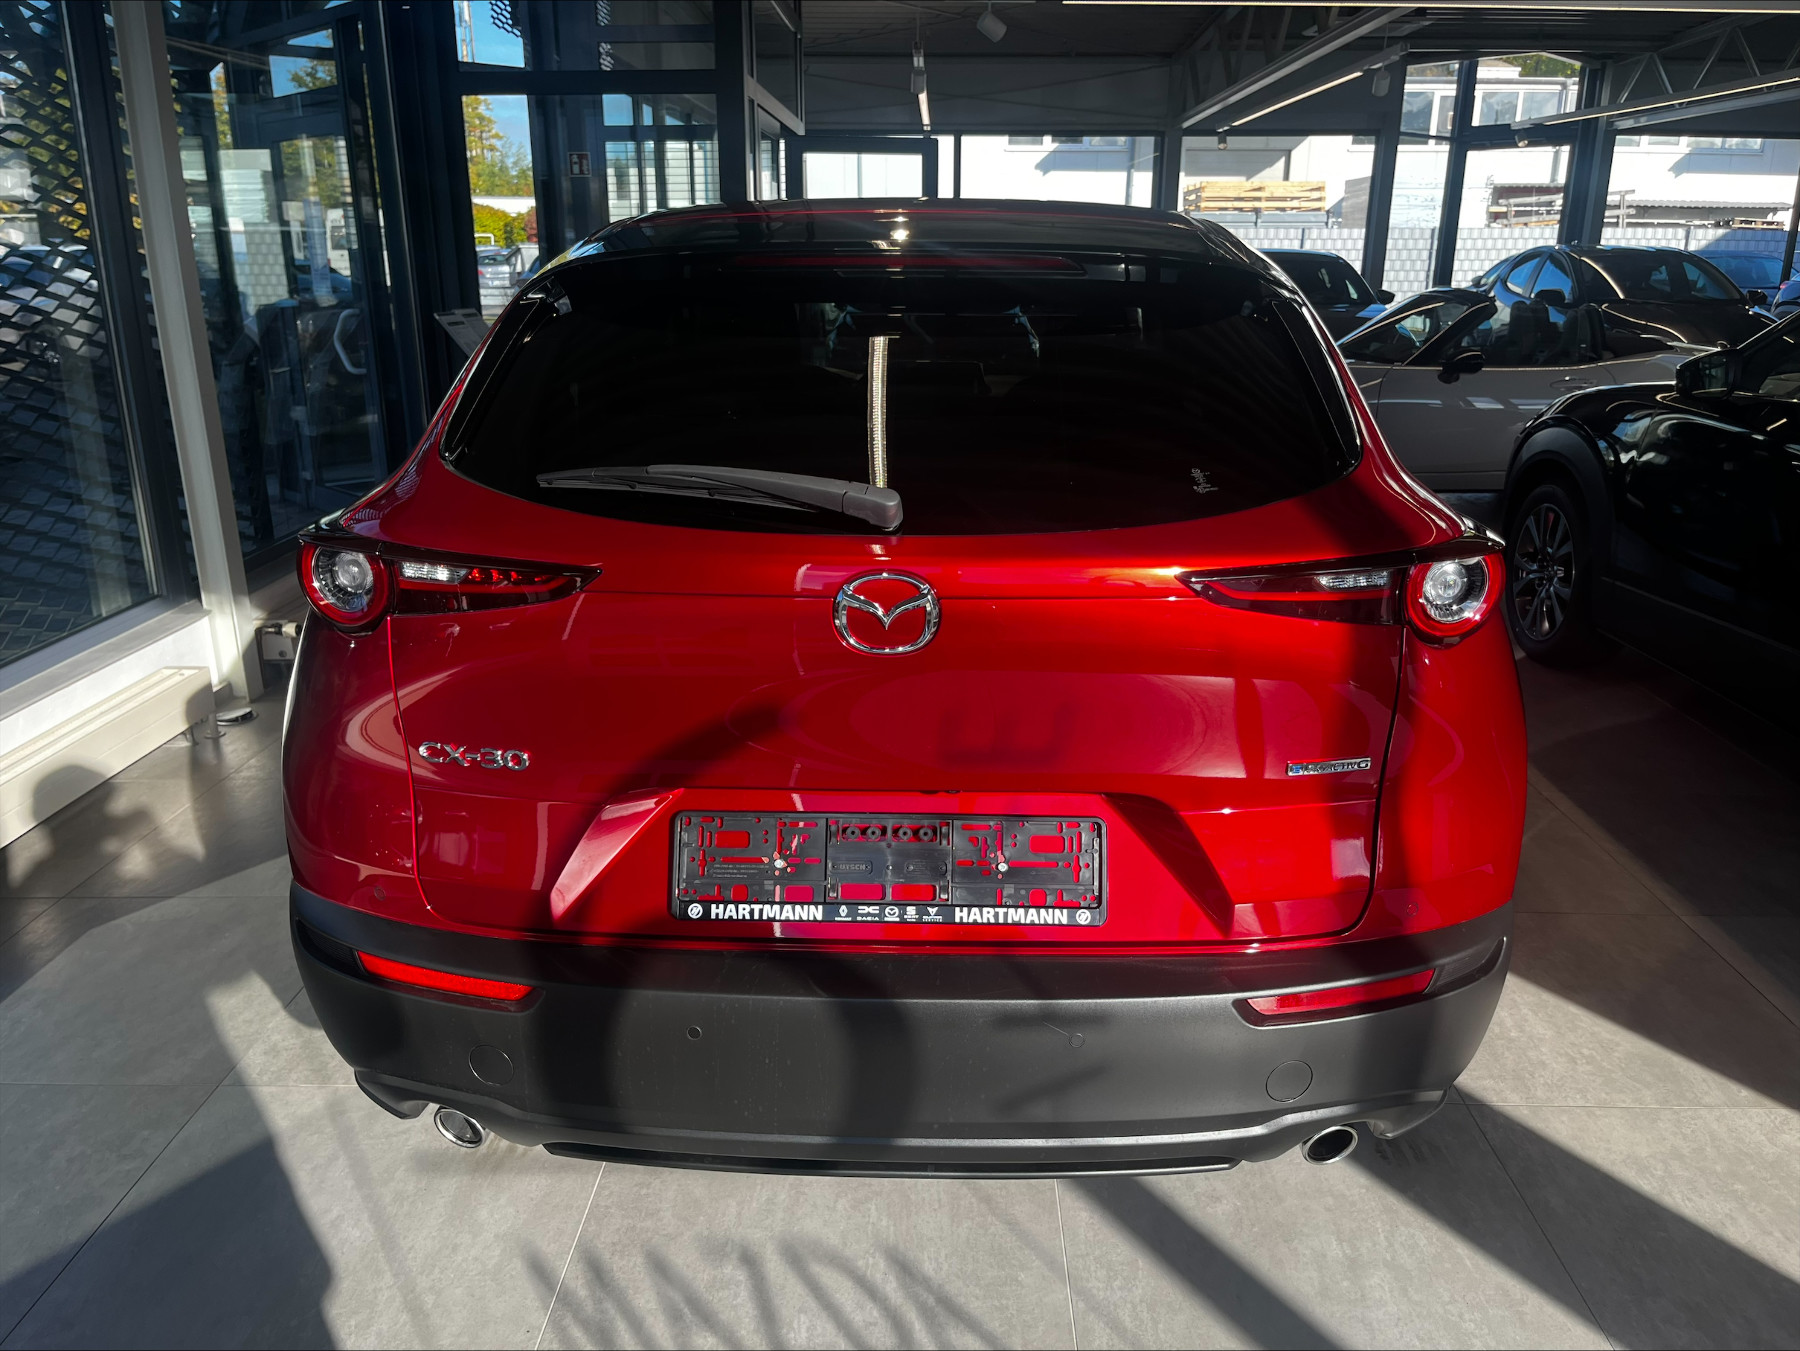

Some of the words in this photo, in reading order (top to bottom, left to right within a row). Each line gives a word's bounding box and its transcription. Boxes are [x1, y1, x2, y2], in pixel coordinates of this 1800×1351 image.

[418, 741, 531, 771] CX-30
[710, 903, 823, 920] HARTMANN
[954, 906, 1068, 925] HARTMANN
